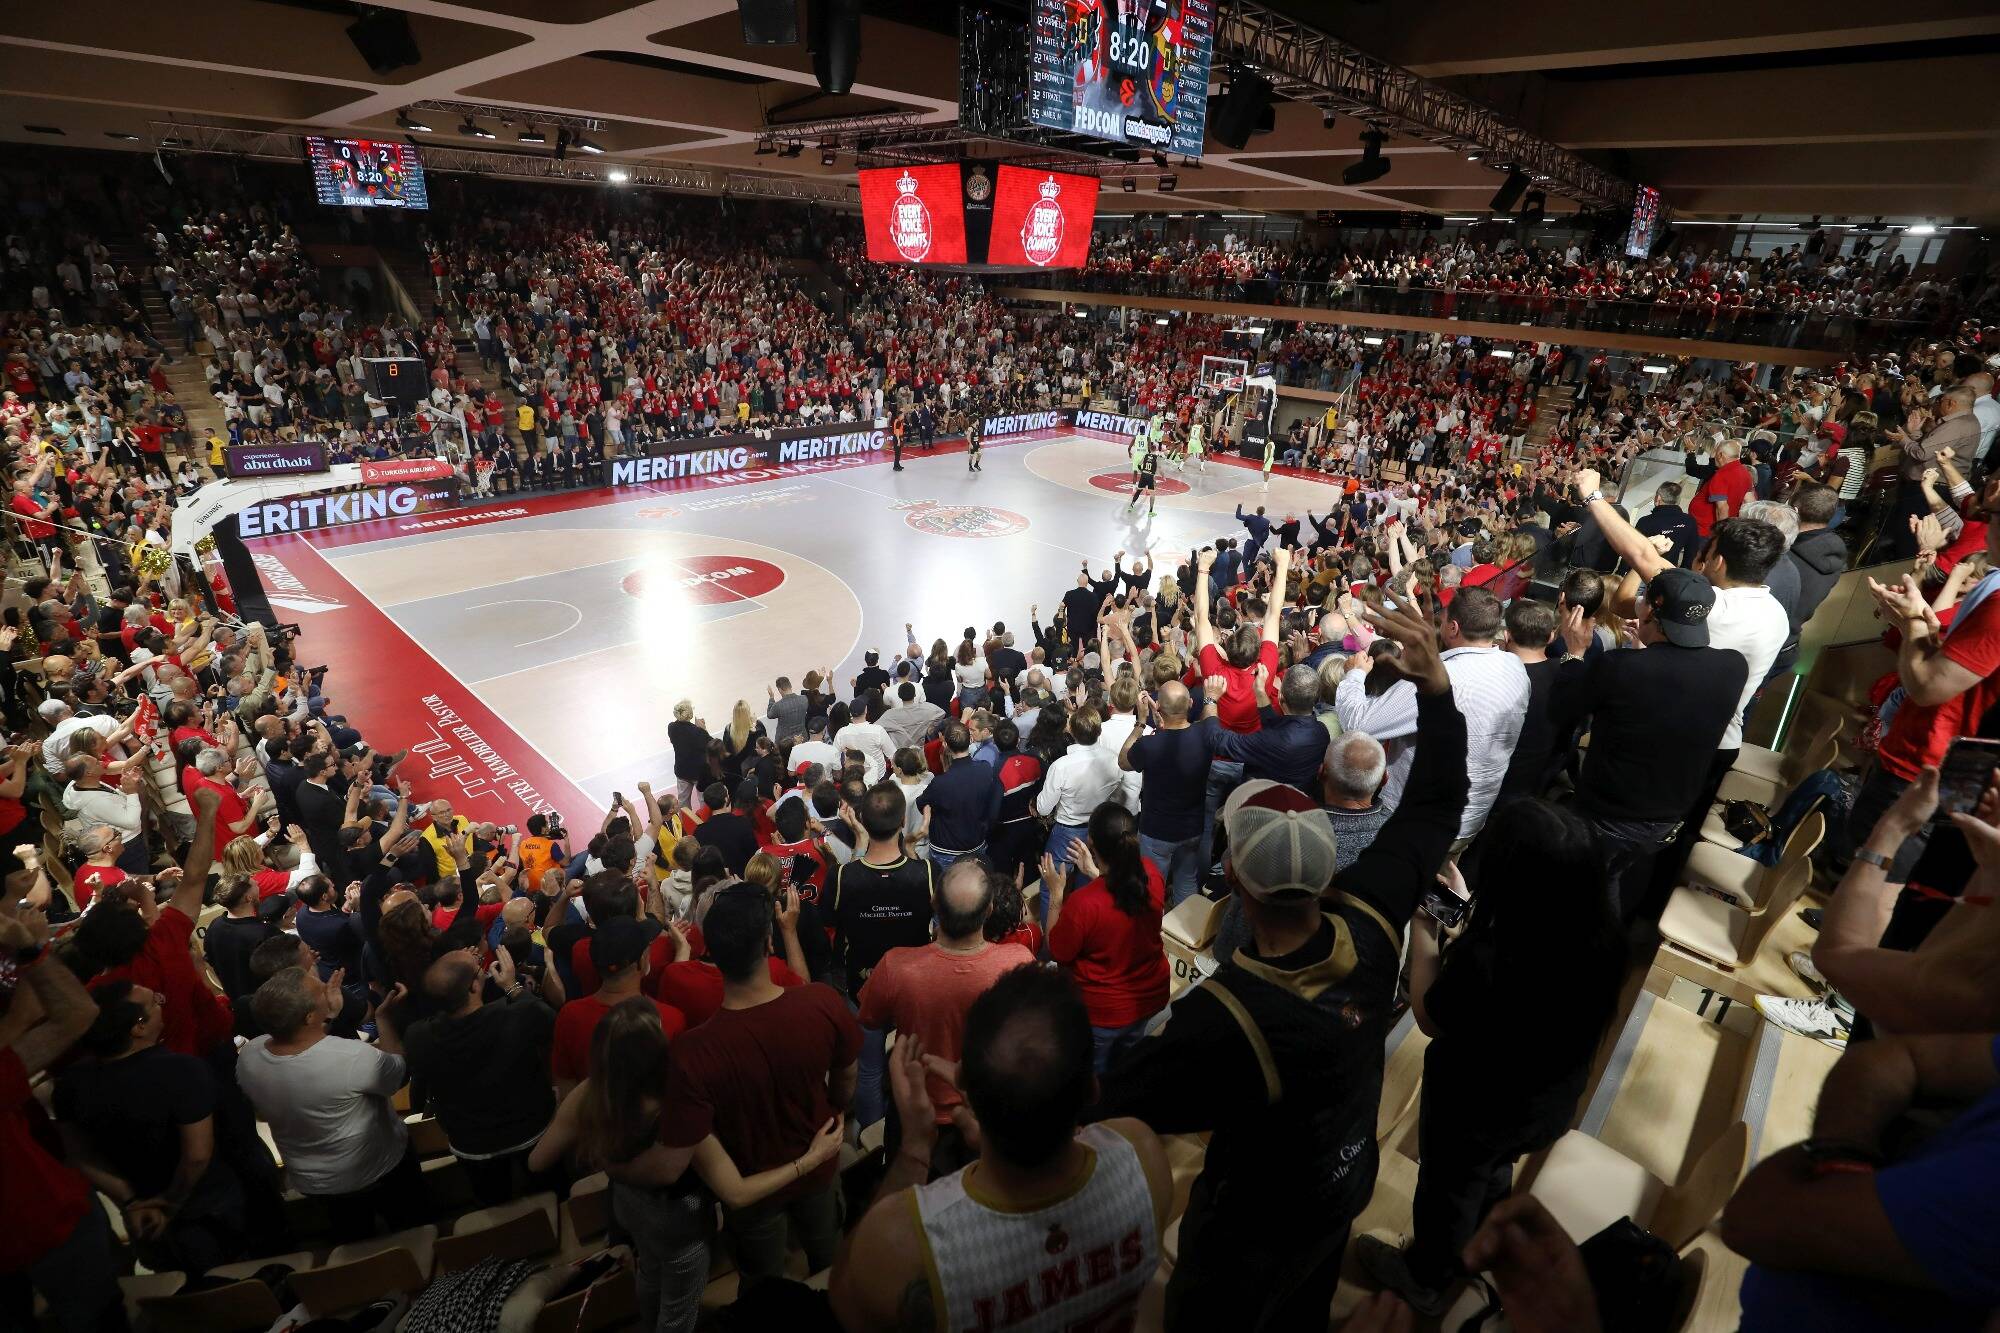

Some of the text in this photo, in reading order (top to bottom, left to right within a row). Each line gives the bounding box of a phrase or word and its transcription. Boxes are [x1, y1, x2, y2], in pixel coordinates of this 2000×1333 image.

[1034, 53, 1042, 63] 22
[1110, 32, 1149, 70] 8:20
[1032, 90, 1040, 100] 32
[1031, 108, 1040, 119] 55
[1074, 105, 1120, 136] FEDCOM
[341, 147, 351, 159] 0
[380, 150, 389, 162] 2
[357, 172, 383, 182] 8:20
[897, 204, 921, 219] EVERY
[1034, 207, 1058, 224] EVERY
[900, 218, 923, 232] VOICE
[1033, 222, 1055, 237] VOICE
[389, 363, 398, 376] 8
[243, 452, 280, 460] experience
[243, 456, 312, 471] abu dhabi
[380, 464, 437, 477] TURKISH AIRLINES
[705, 457, 865, 484] MONACO
[196, 502, 223, 526] SPALDING
[239, 486, 418, 538] ERiTKiNG
[421, 693, 463, 729] PASTOR
[452, 723, 519, 784] IMMOBILIER
[1696, 987, 1733, 1026] 11
[962, 1222, 1145, 1333] JAMES
